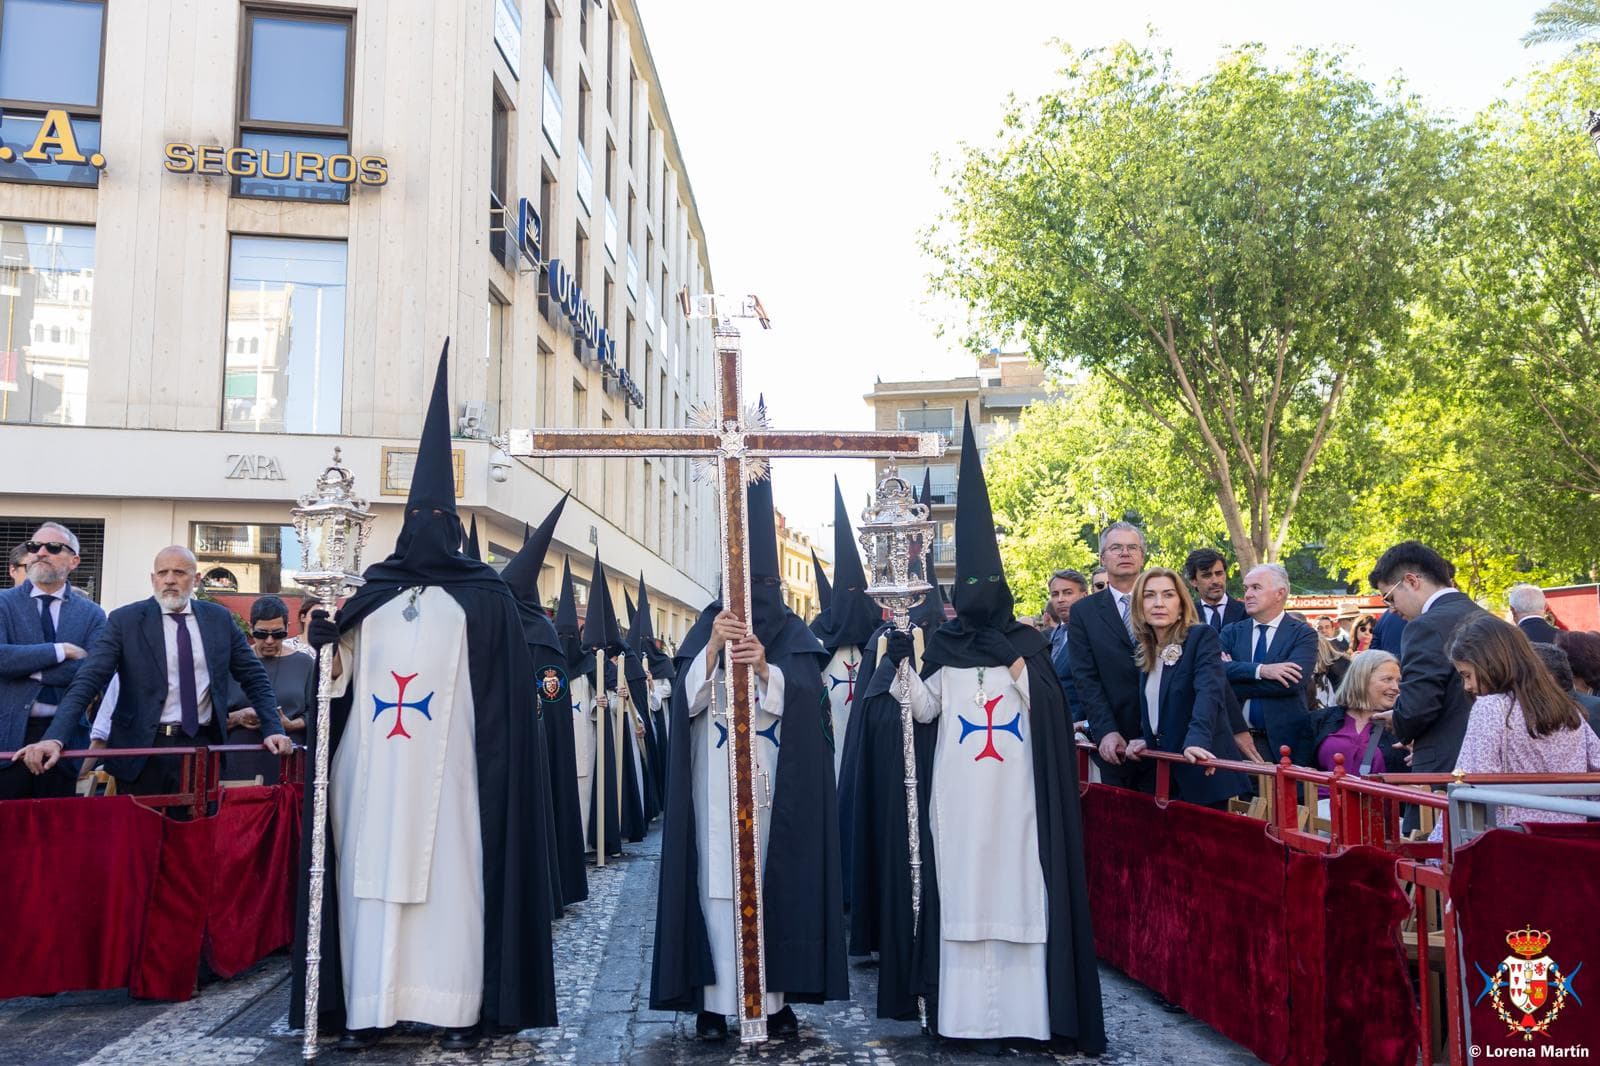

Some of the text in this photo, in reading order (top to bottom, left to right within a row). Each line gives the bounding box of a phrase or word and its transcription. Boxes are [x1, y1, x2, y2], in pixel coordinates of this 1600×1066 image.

[0, 109, 107, 168] .A.
[163, 142, 389, 187] SEGUROS
[549, 258, 600, 349] OCASO
[225, 453, 287, 481] ZARA
[1286, 598, 1332, 607] QUIOSCO
